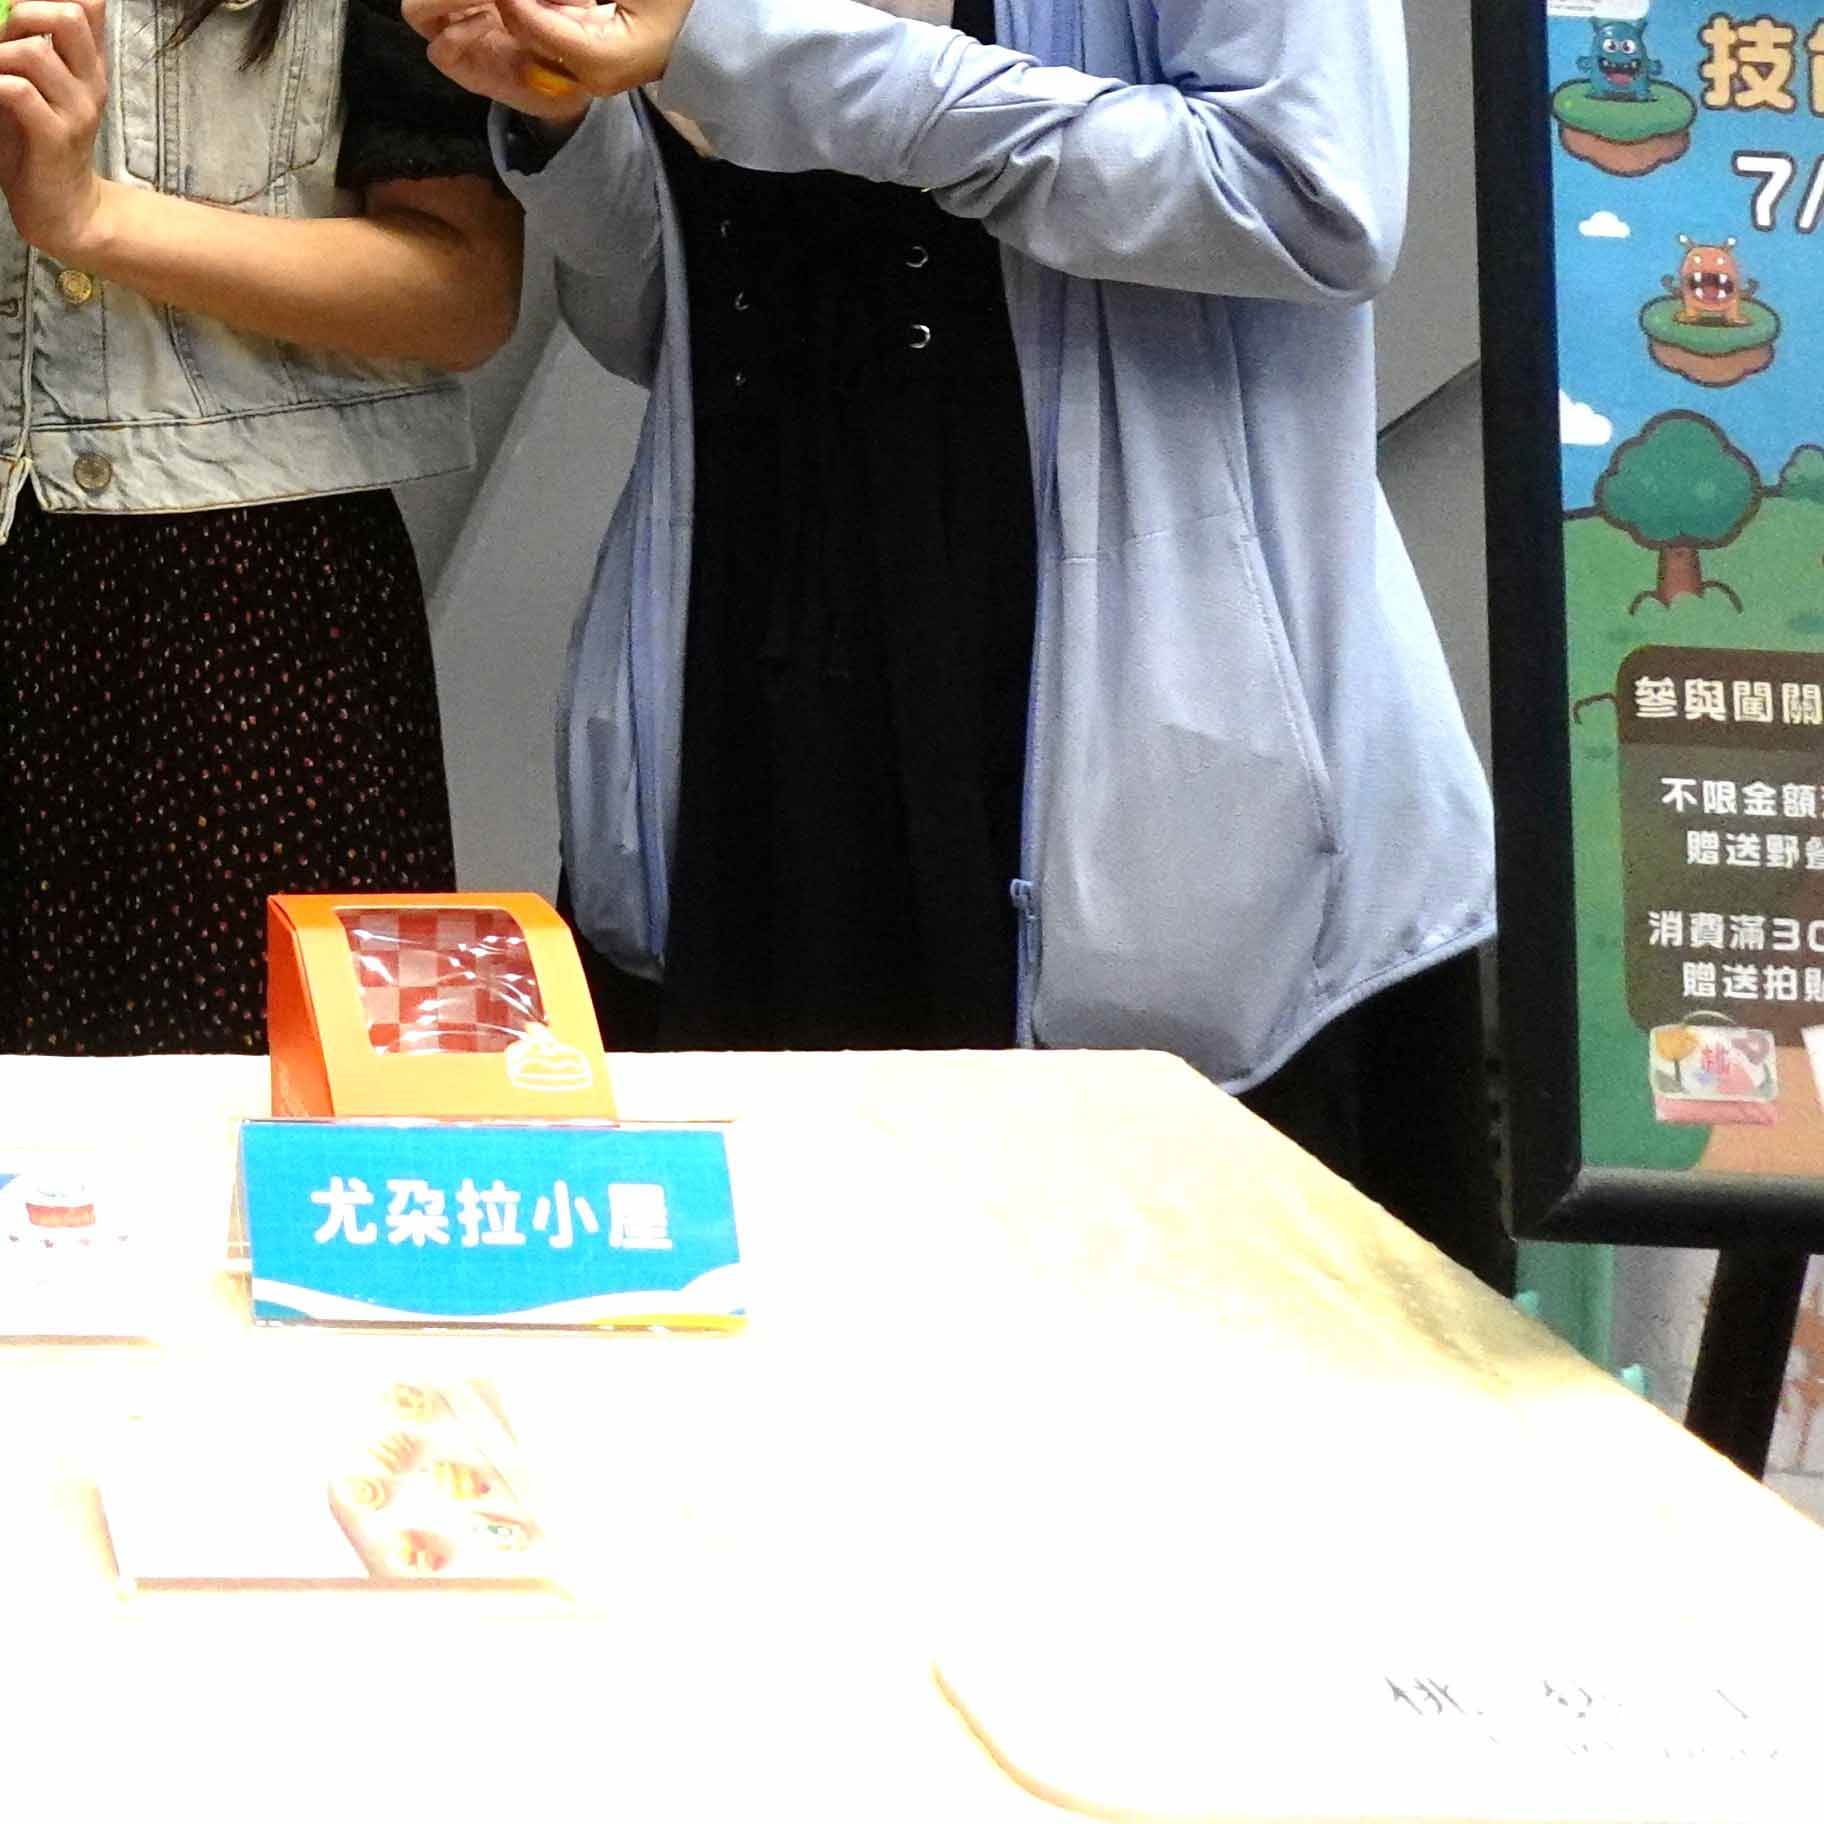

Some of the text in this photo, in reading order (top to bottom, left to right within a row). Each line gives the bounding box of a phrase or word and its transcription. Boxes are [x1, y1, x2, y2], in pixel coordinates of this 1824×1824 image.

[1699, 13, 1824, 116] 技
[1635, 676, 1824, 725] 參與闖關
[309, 1175, 673, 1251] 尤朵拉小屋
